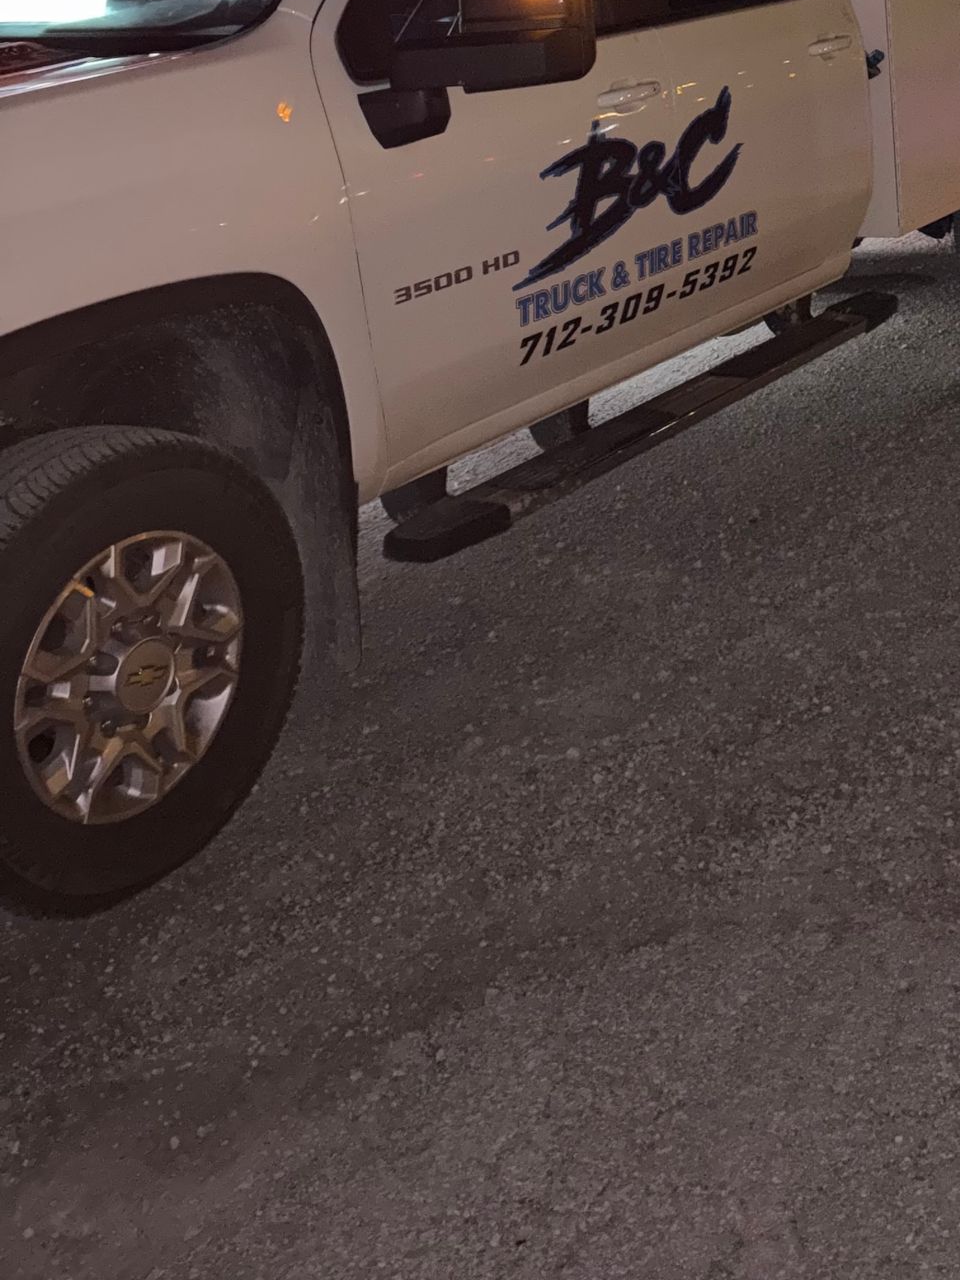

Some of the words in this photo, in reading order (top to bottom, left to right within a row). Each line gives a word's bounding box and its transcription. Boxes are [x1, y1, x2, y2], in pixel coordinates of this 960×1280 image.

[512, 85, 744, 292] B&C
[394, 265, 473, 305] 3500
[482, 250, 520, 276] HD
[515, 265, 606, 327] TRUCK
[611, 260, 630, 291] &
[635, 238, 682, 281] TIRE
[688, 210, 758, 261] REPAIR
[519, 246, 758, 367] 712-309-5392
